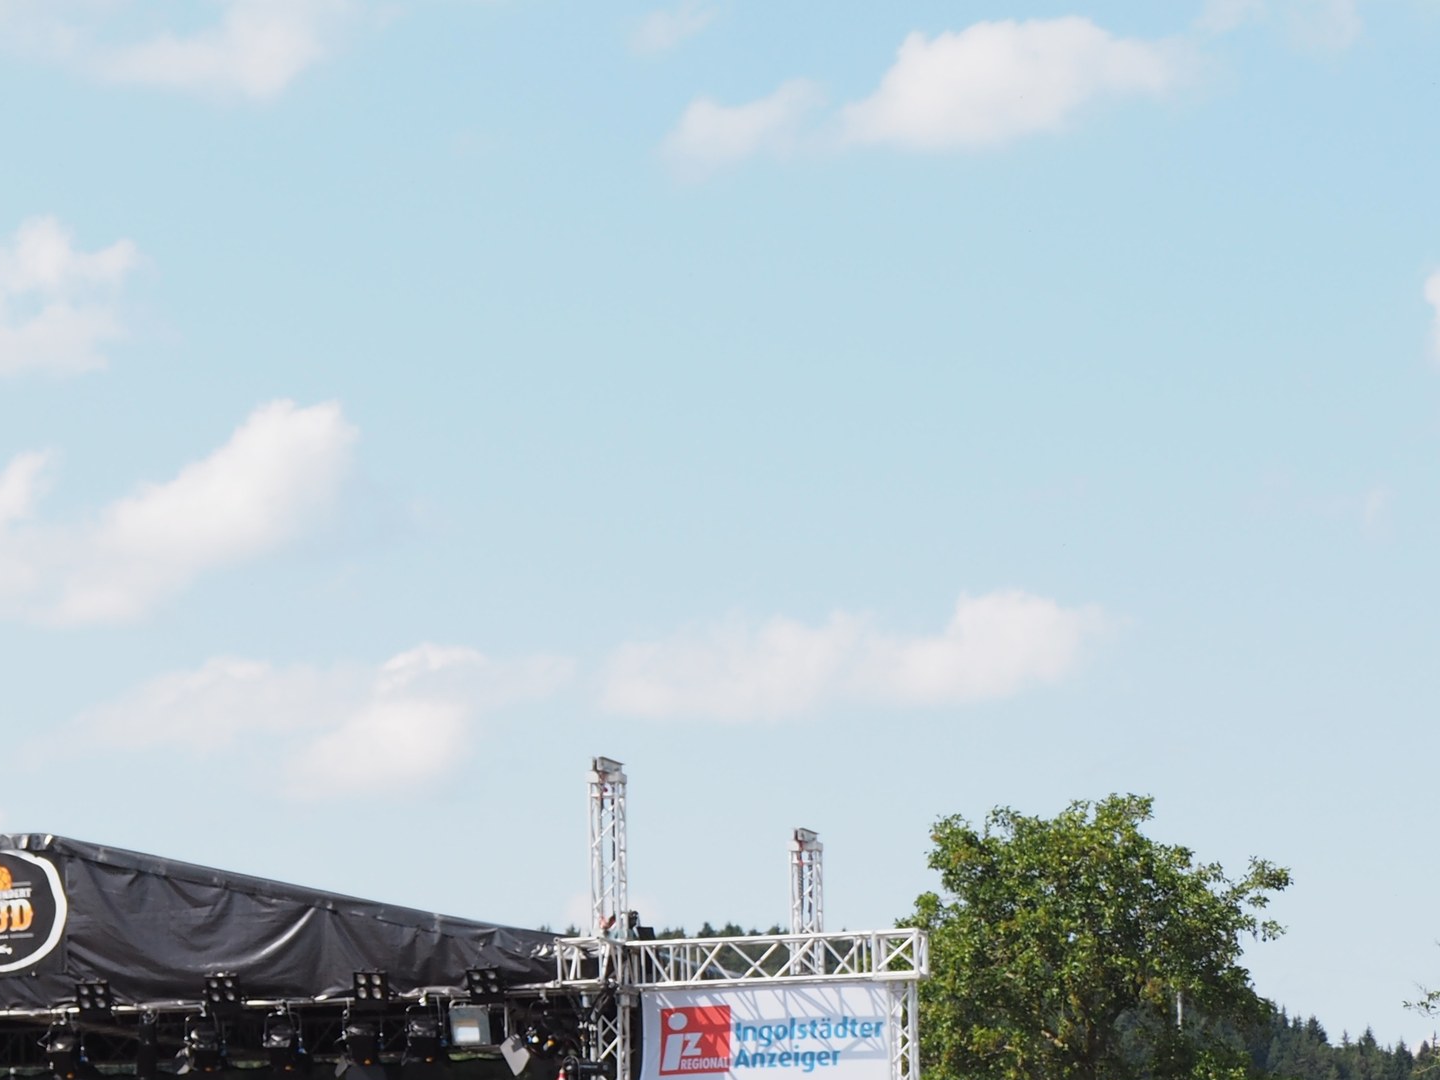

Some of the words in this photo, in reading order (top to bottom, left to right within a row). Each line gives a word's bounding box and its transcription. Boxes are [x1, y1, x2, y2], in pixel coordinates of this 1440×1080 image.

[734, 1016, 884, 1046] Ingolstädter
[680, 1056, 730, 1071] REGIONAL
[734, 1045, 841, 1073] Anzeiger
